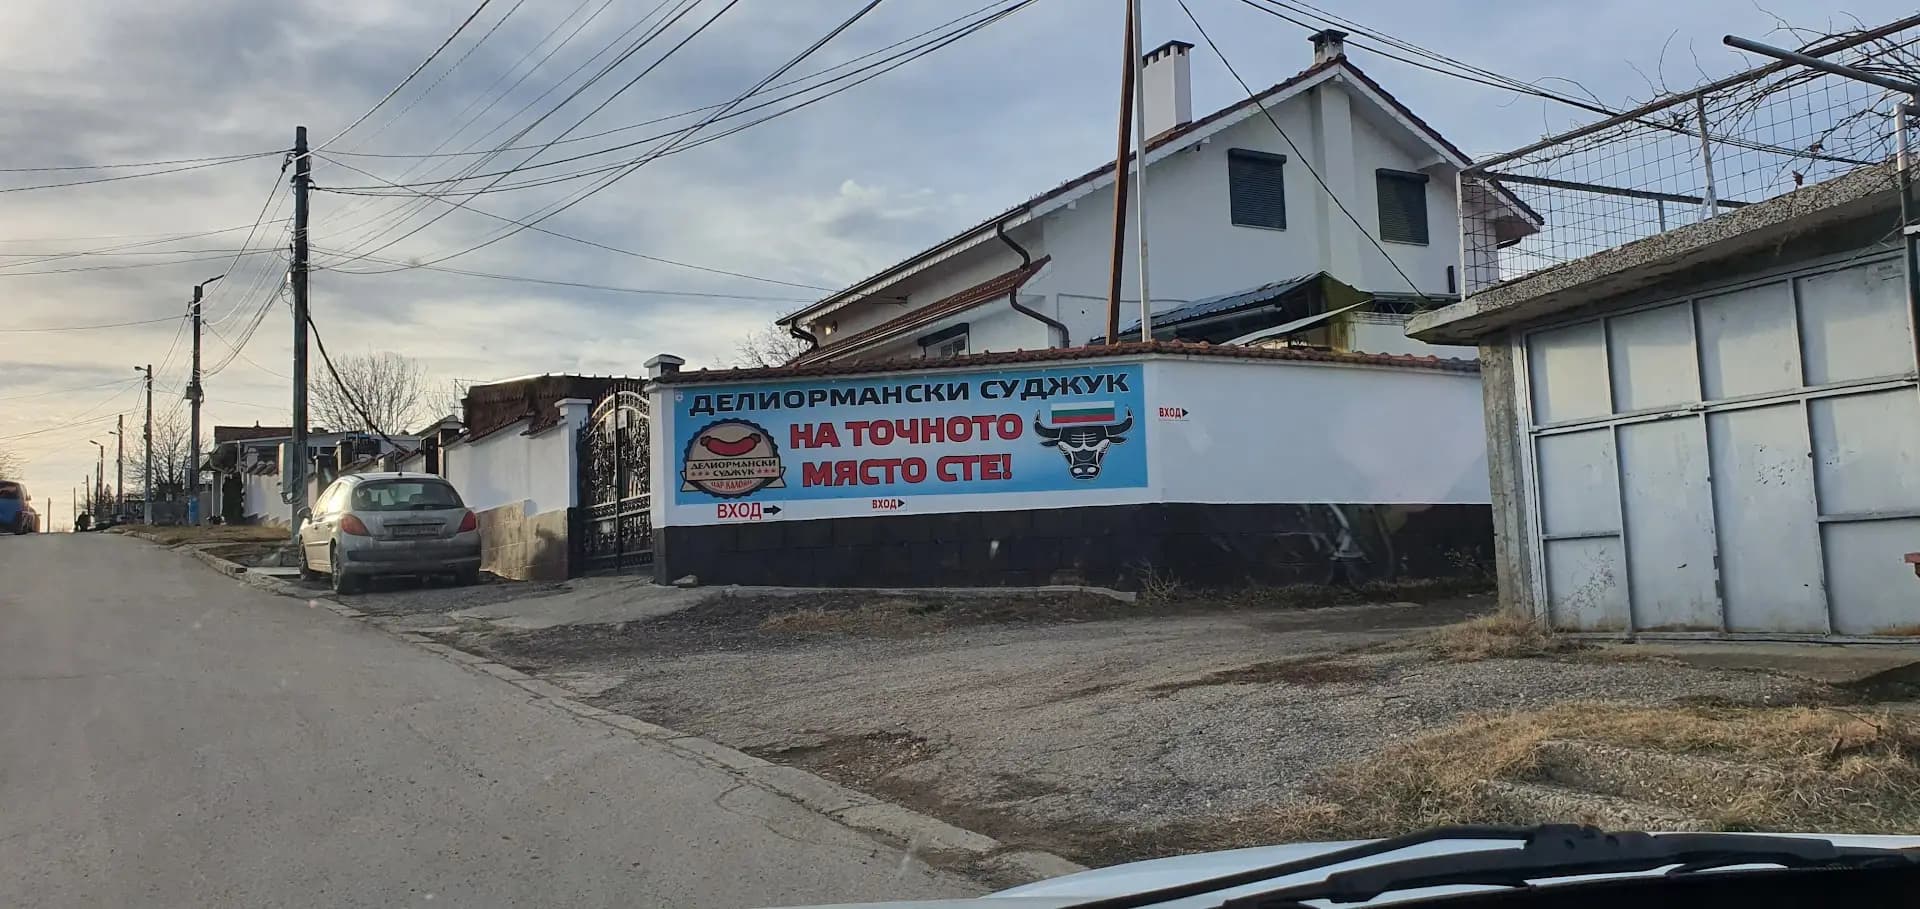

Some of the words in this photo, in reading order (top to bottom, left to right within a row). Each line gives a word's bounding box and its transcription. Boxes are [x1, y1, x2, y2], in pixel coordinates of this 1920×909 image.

[689, 382, 969, 416] ДЕЛИОРМАНСКИ
[980, 374, 1130, 401] СУДЖУК
[1159, 407, 1182, 419] ВХОД
[789, 422, 841, 449] НА
[845, 413, 1024, 447] ТОЧНОТО
[690, 459, 776, 470] ДЕЛИОРМАНСКИ
[802, 457, 927, 487] МЯСТО
[936, 453, 1012, 482] СТЕ!
[713, 468, 755, 477] СУДЖУК
[717, 502, 762, 520] ВХОД
[872, 499, 897, 510] ВХОД
